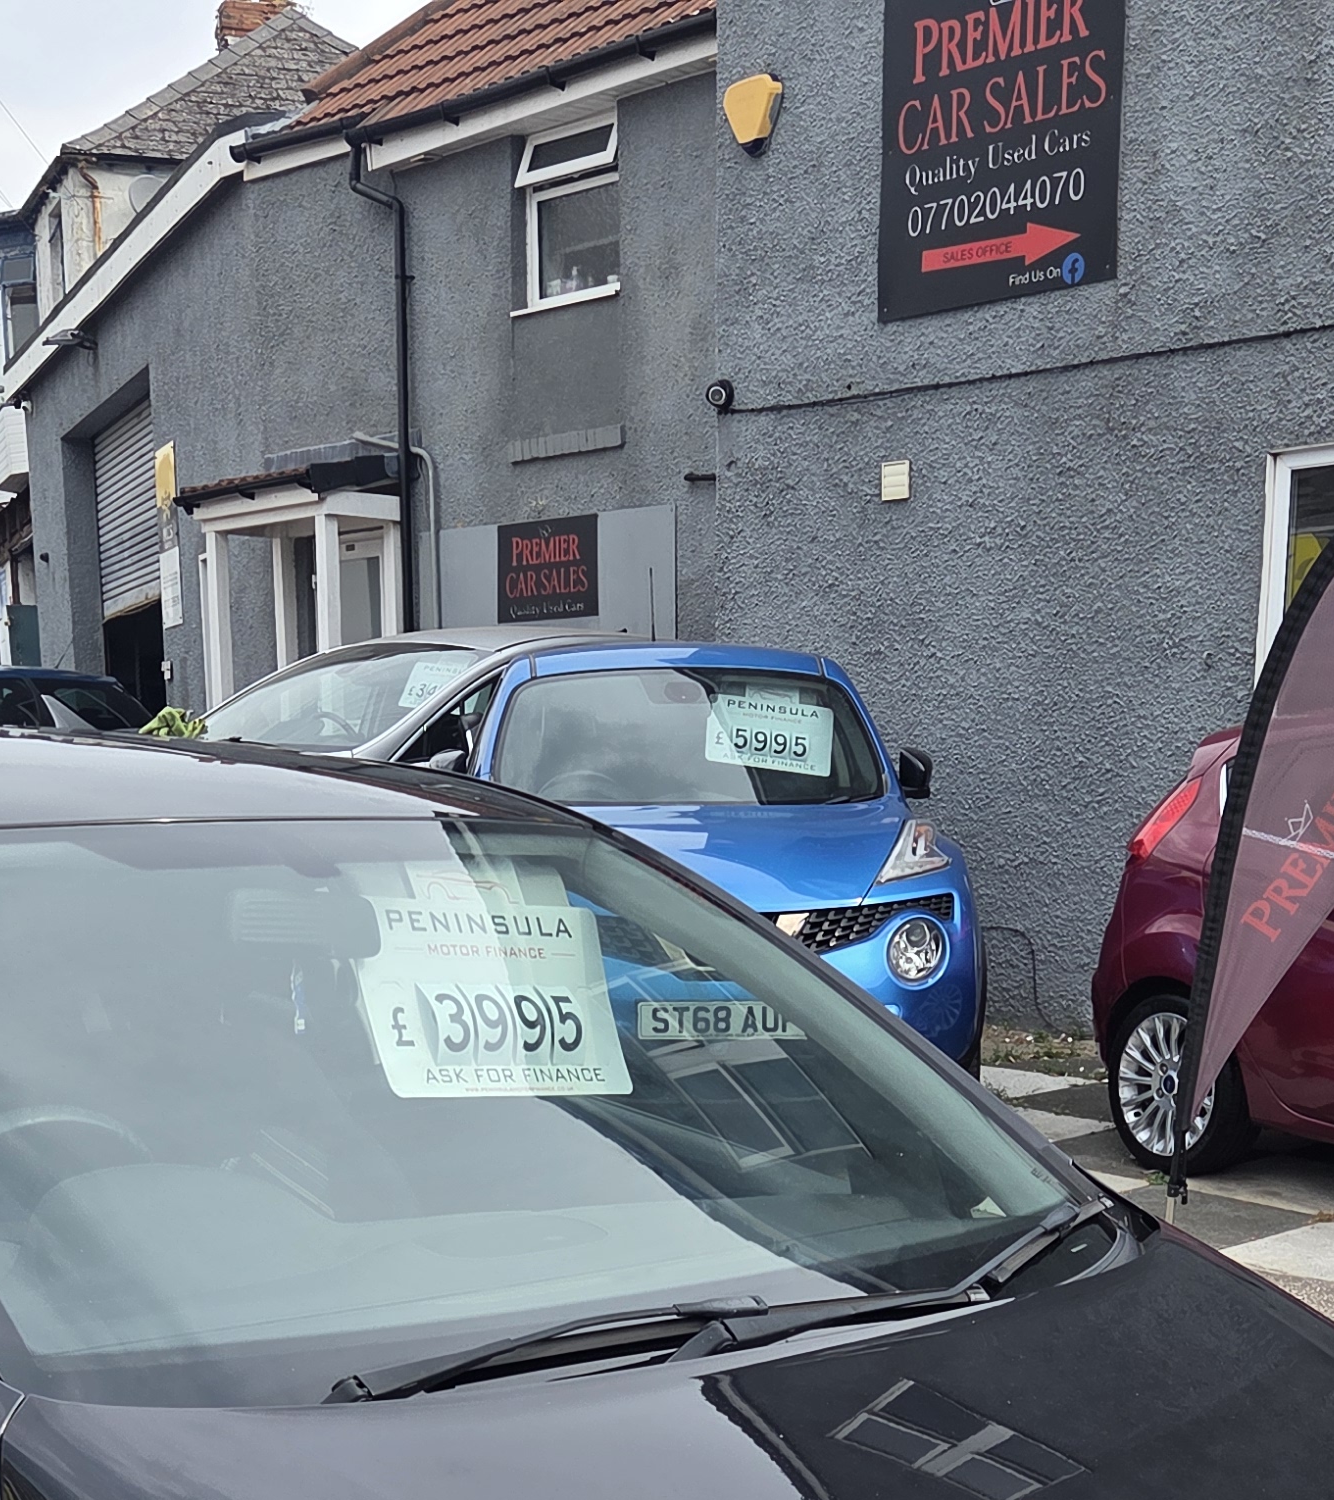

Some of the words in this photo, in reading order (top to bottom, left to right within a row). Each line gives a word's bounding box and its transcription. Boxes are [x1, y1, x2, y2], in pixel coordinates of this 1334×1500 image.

[912, 0, 1090, 84] PREMIER
[897, 87, 975, 155] CAR
[983, 49, 1107, 134] SALES
[904, 155, 980, 195] Quality
[987, 134, 1037, 170] Used
[1043, 129, 1092, 156] Cars
[907, 168, 1085, 237] 07702044070
[942, 245, 974, 264] SALES
[975, 241, 1012, 258] OFFICE
[1008, 273, 1030, 287] Find
[1031, 269, 1045, 282] Us
[1047, 267, 1061, 279] On
[511, 534, 581, 566] PREMIER
[506, 571, 538, 598] CAR
[540, 565, 588, 595] SALES
[727, 699, 820, 719] PENINSULA
[742, 712, 769, 720] MOTOR
[770, 715, 803, 724] FINANCE
[747, 755, 768, 764] FOR
[771, 758, 817, 771] FINANCE
[385, 908, 573, 939] PENINSULA
[426, 943, 480, 958] MOTOR
[485, 945, 547, 960] FINANCE
[651, 1005, 732, 1034] ST68
[426, 1067, 469, 1084] ASK
[474, 1067, 517, 1084] FOR
[522, 1067, 606, 1083] FINANCE
